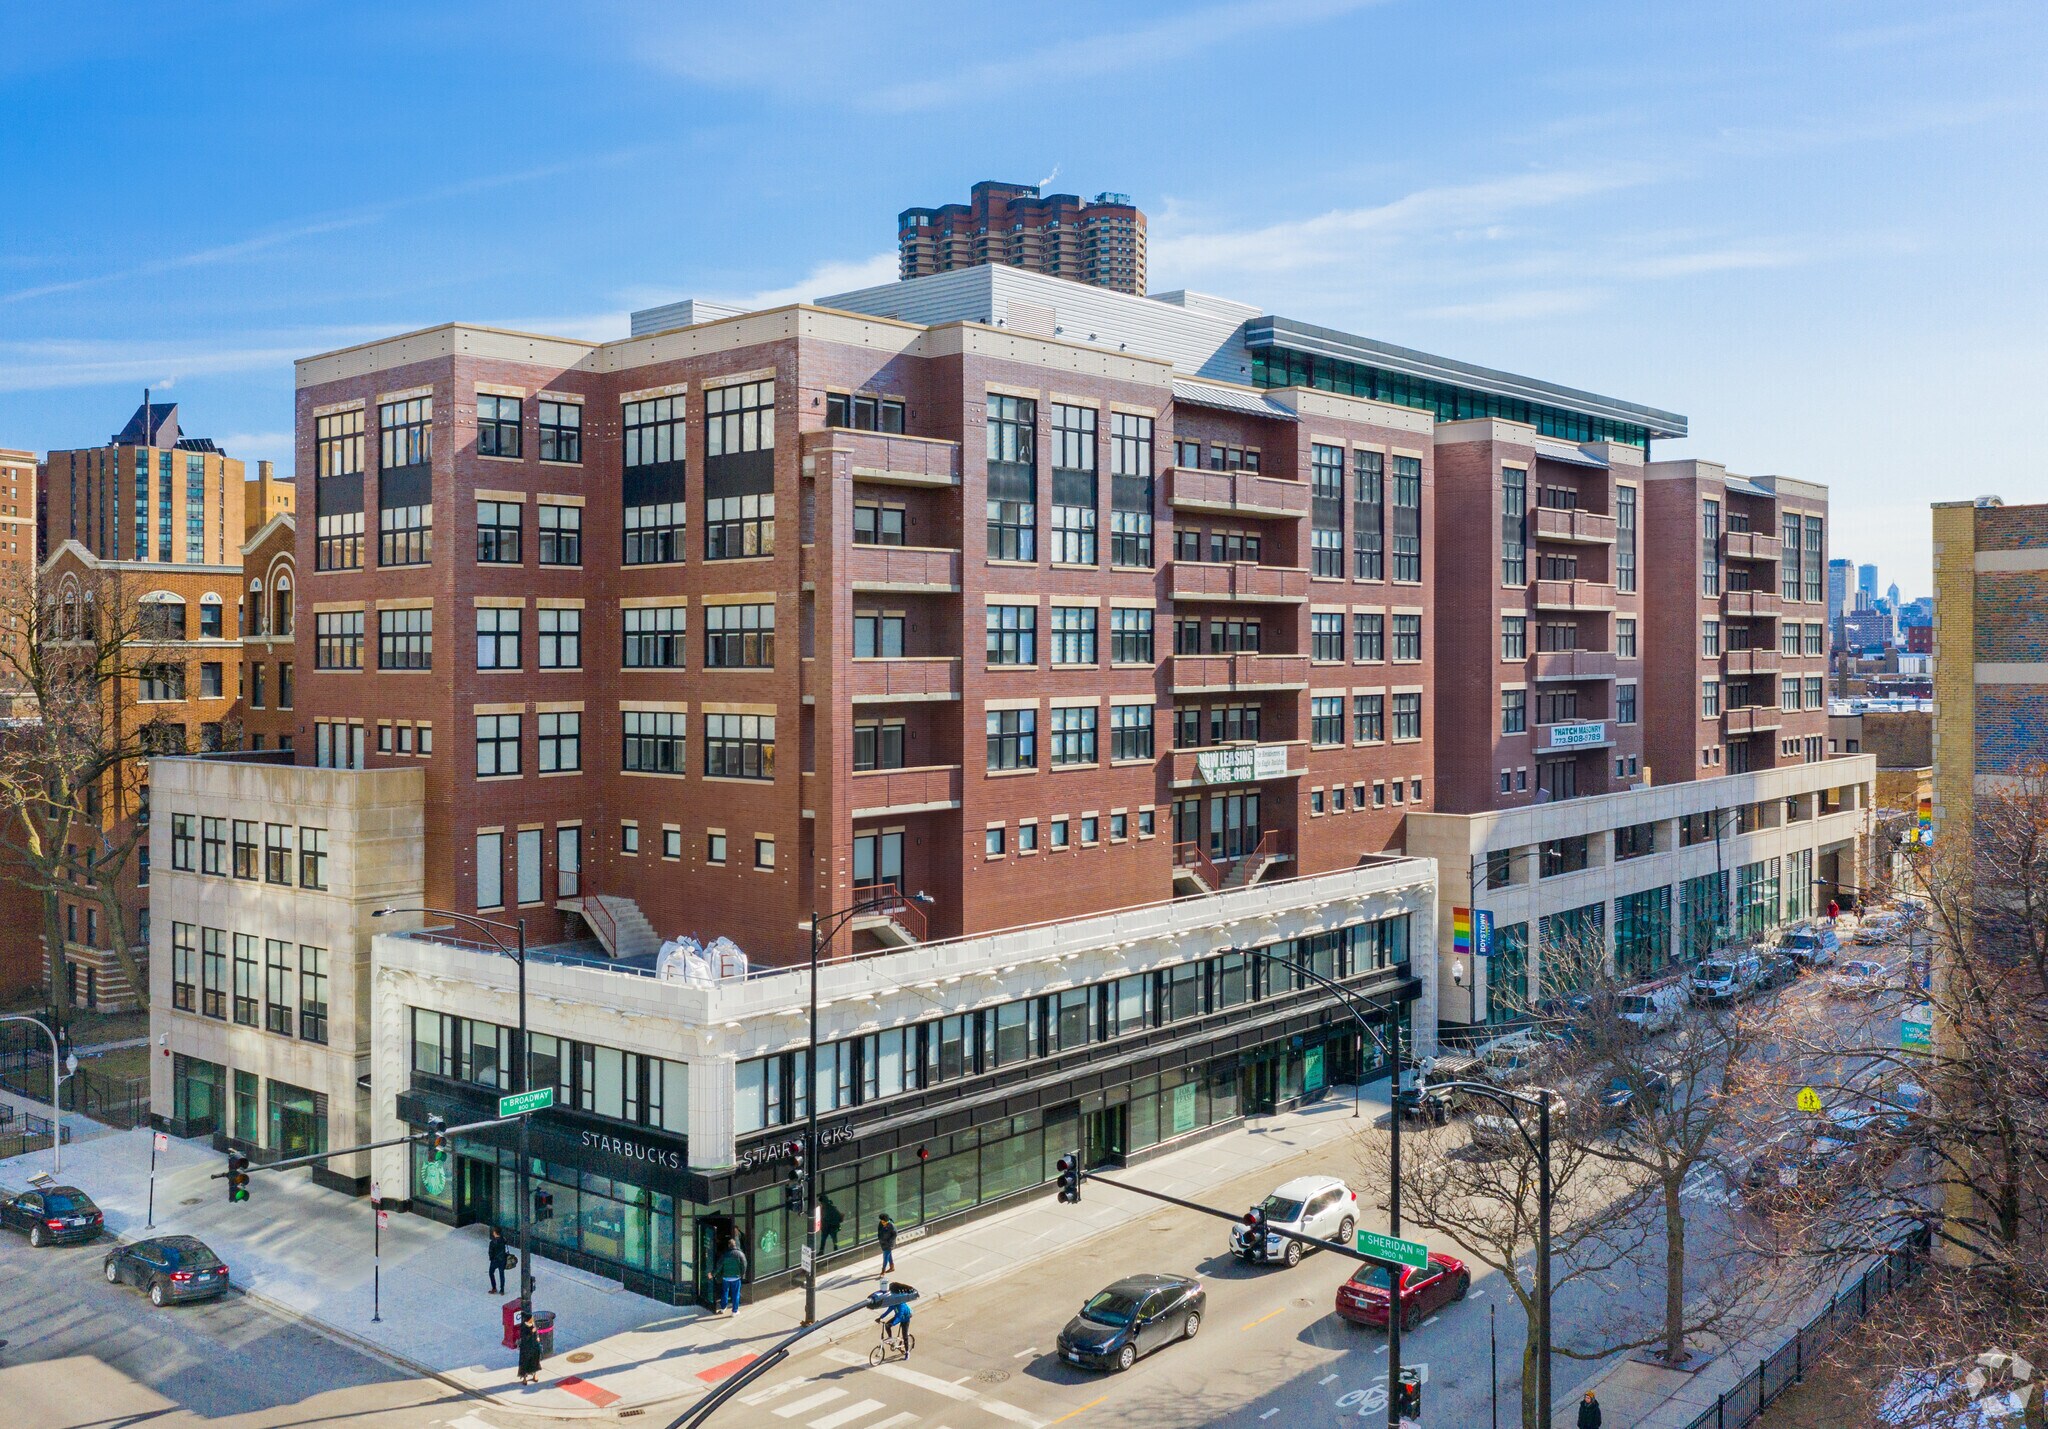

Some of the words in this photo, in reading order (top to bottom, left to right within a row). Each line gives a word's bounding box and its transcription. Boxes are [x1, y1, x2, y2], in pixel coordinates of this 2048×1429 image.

[1554, 727, 1578, 736] THATCH
[1199, 751, 1219, 769] NOW
[1220, 750, 1253, 768] LEASING
[1479, 913, 1487, 952] BOYSTOWN
[509, 1091, 549, 1107] BROADWAY
[581, 1130, 679, 1169] STARBUCKS
[743, 1124, 855, 1167] STARCKS
[1367, 1234, 1413, 1255] SHERIDAN
[1416, 1248, 1425, 1256] RD
[1380, 1249, 1397, 1259] 3900
